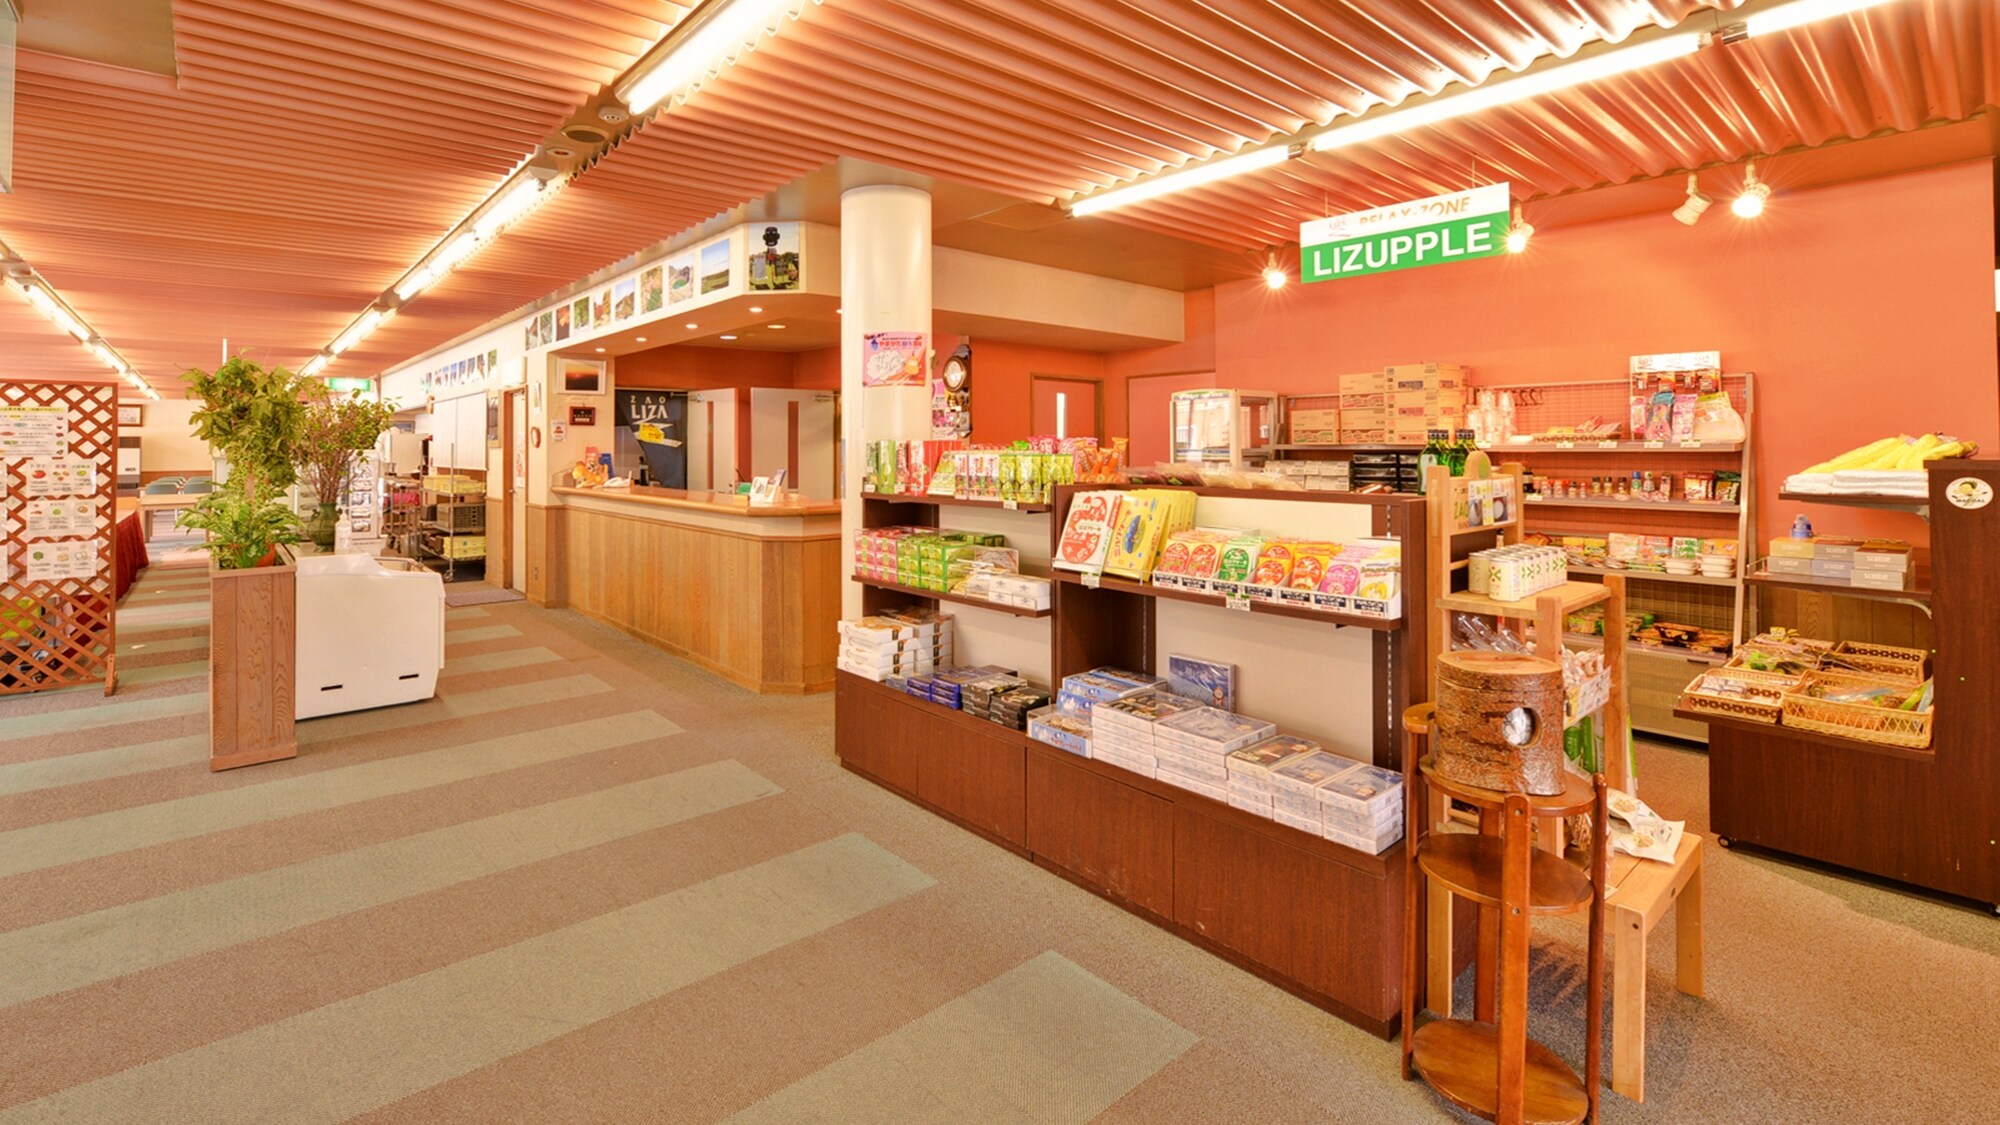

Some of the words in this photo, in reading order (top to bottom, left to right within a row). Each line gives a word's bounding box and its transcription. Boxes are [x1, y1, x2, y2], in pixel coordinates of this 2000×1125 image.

[1313, 221, 1492, 277] LIZUPPLE
[630, 395, 666, 404] ZAO
[631, 404, 668, 419] LIZA
